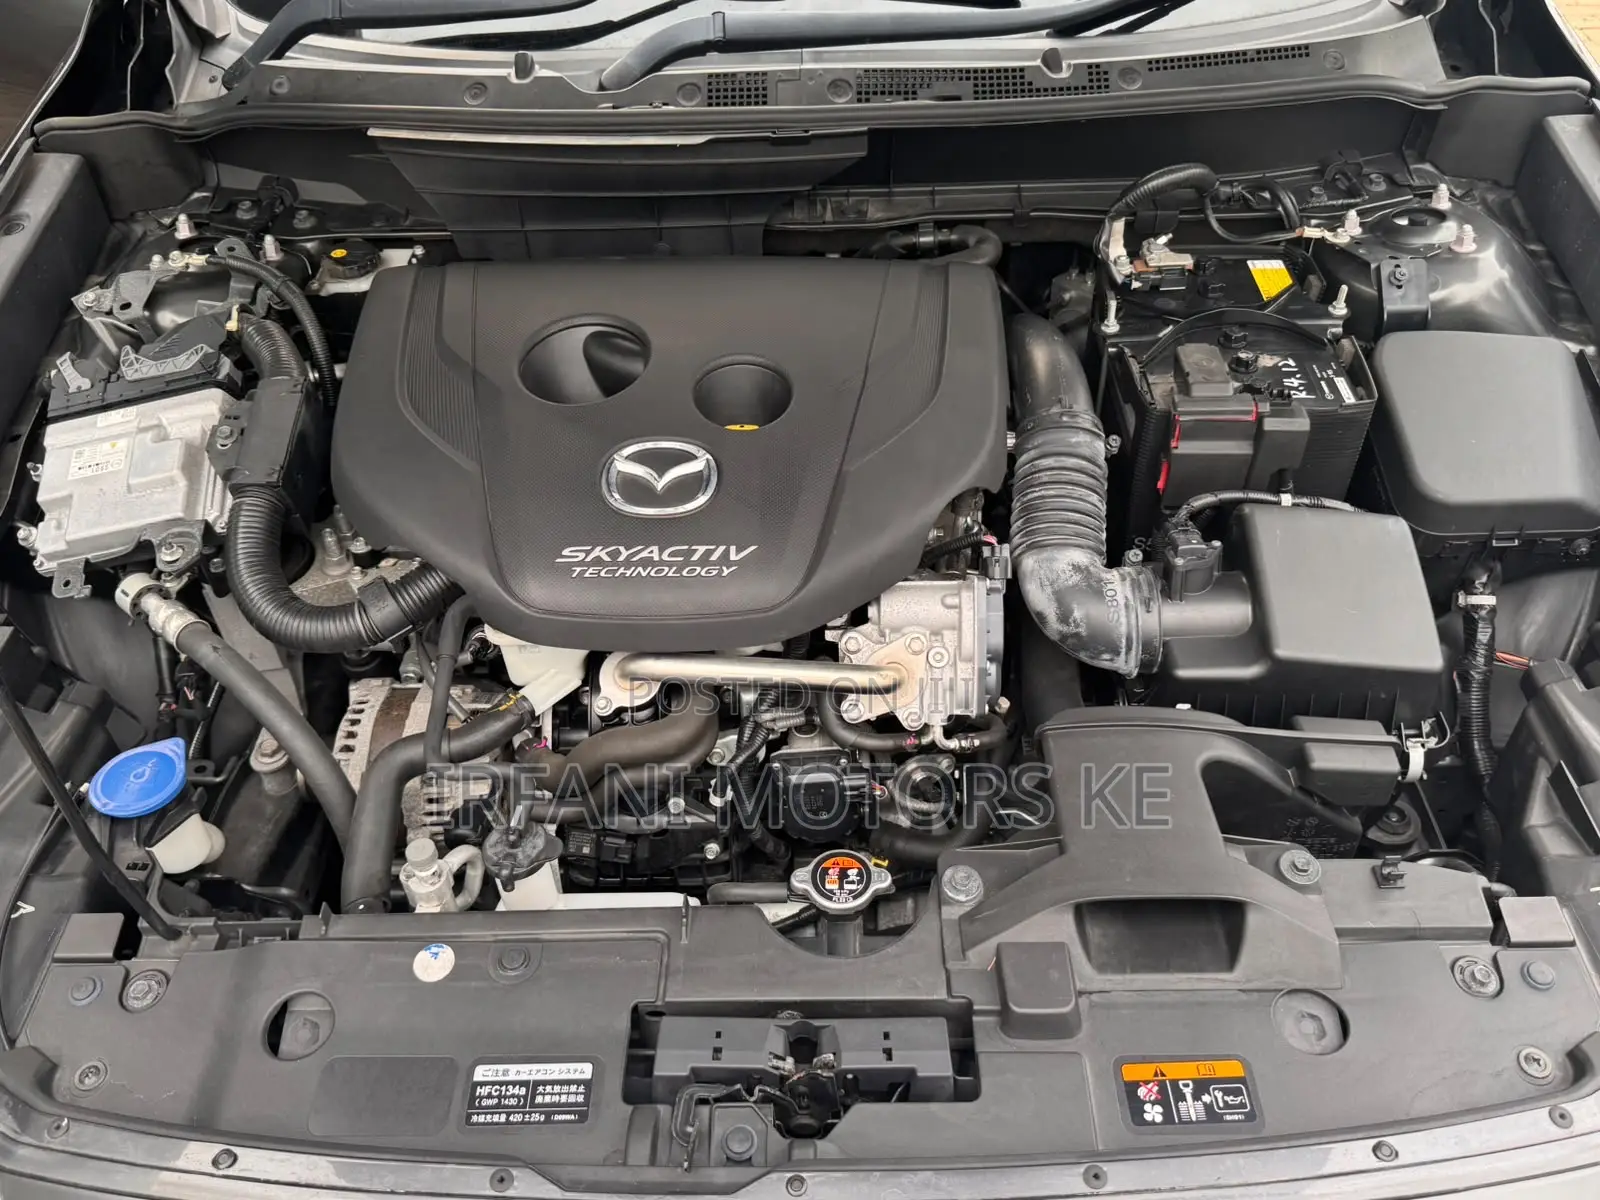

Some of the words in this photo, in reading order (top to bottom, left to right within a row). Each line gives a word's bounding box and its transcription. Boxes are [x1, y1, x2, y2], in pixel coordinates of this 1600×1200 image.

[554, 545, 759, 562] SKYACTIV
[570, 566, 738, 578] TECHNOLOGY
[481, 1068, 511, 1078] ご注意
[514, 1069, 556, 1077] カーエアコン
[557, 1068, 586, 1076] システム
[475, 1084, 527, 1096] HFC134a
